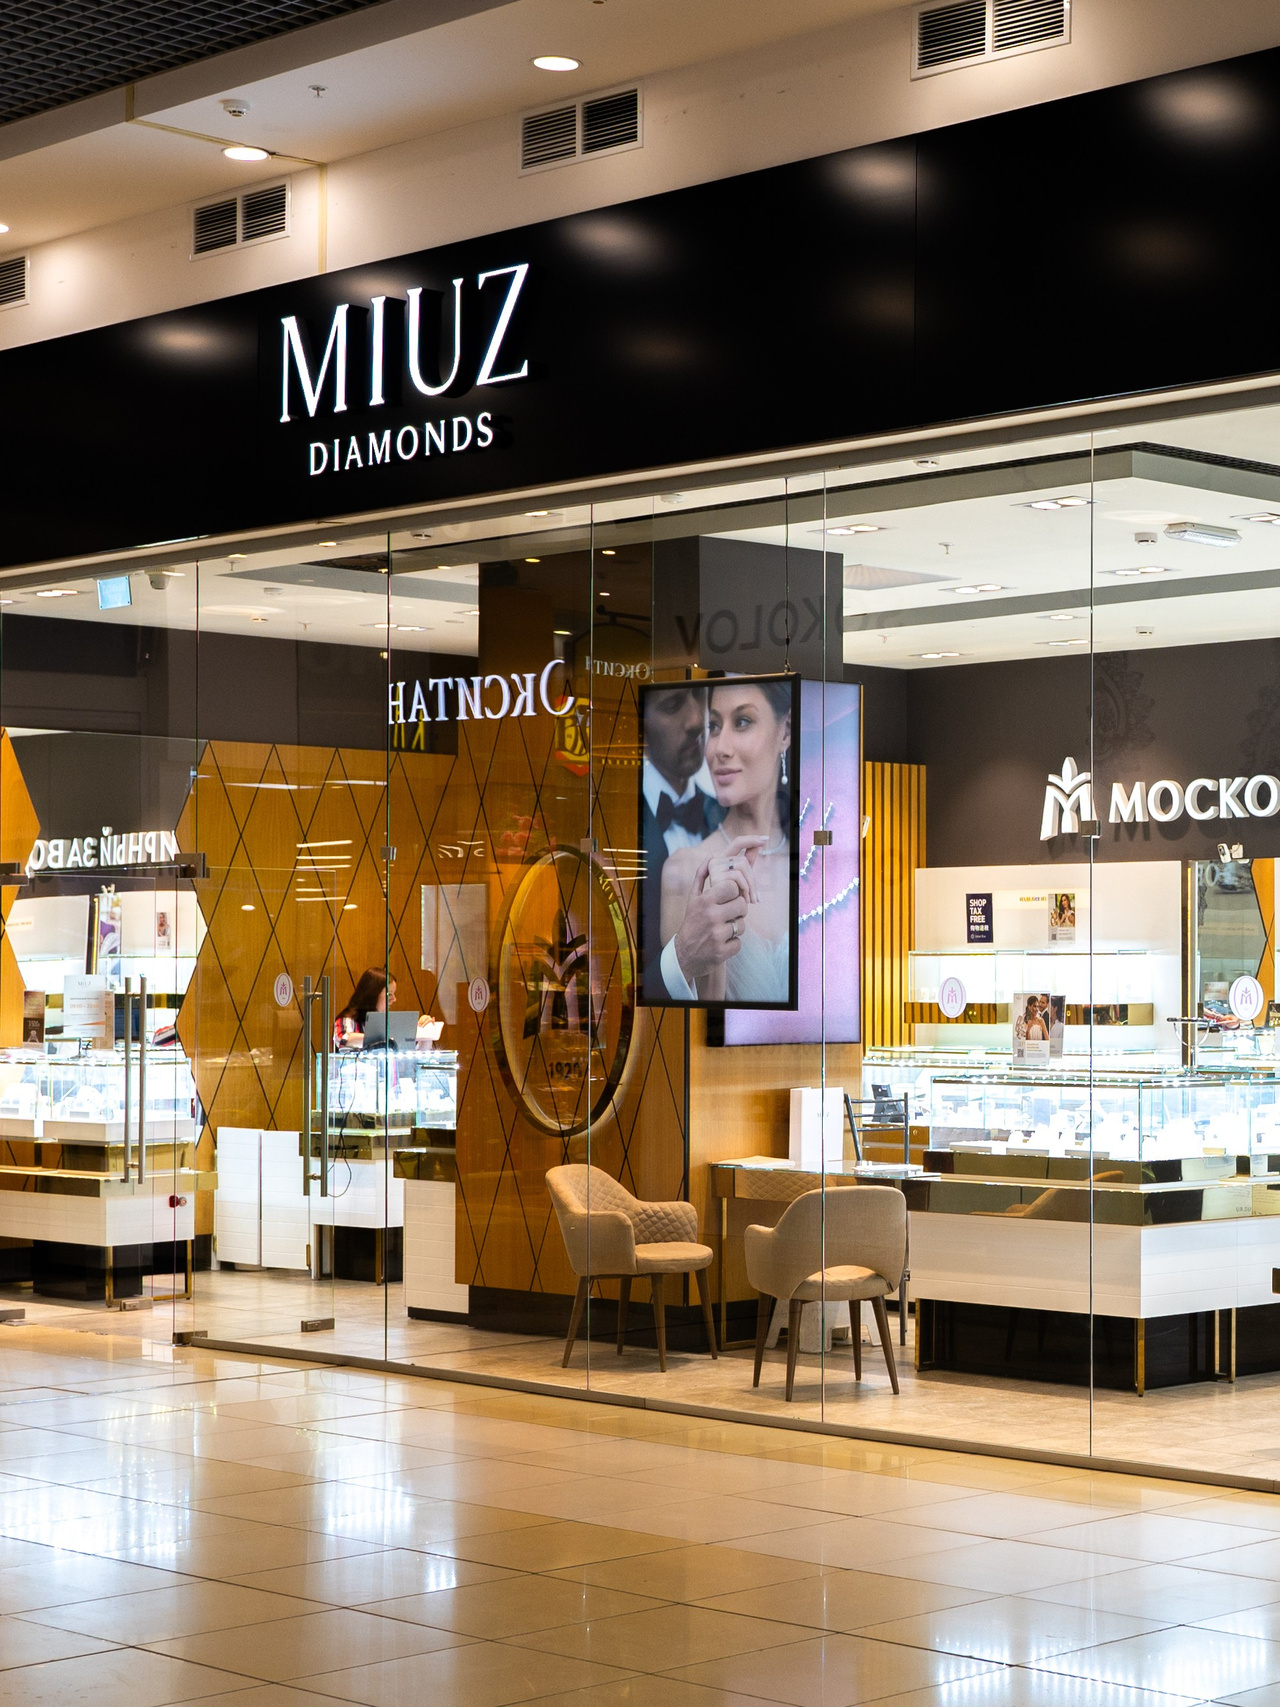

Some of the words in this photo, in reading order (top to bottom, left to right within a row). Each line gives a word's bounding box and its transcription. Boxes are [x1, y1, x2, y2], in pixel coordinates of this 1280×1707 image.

[280, 263, 530, 423] MIUZ
[310, 412, 494, 476] DIAMONDS
[969, 899, 987, 907] SHOP
[969, 907, 982, 915] TAX
[970, 915, 986, 923] FREE
